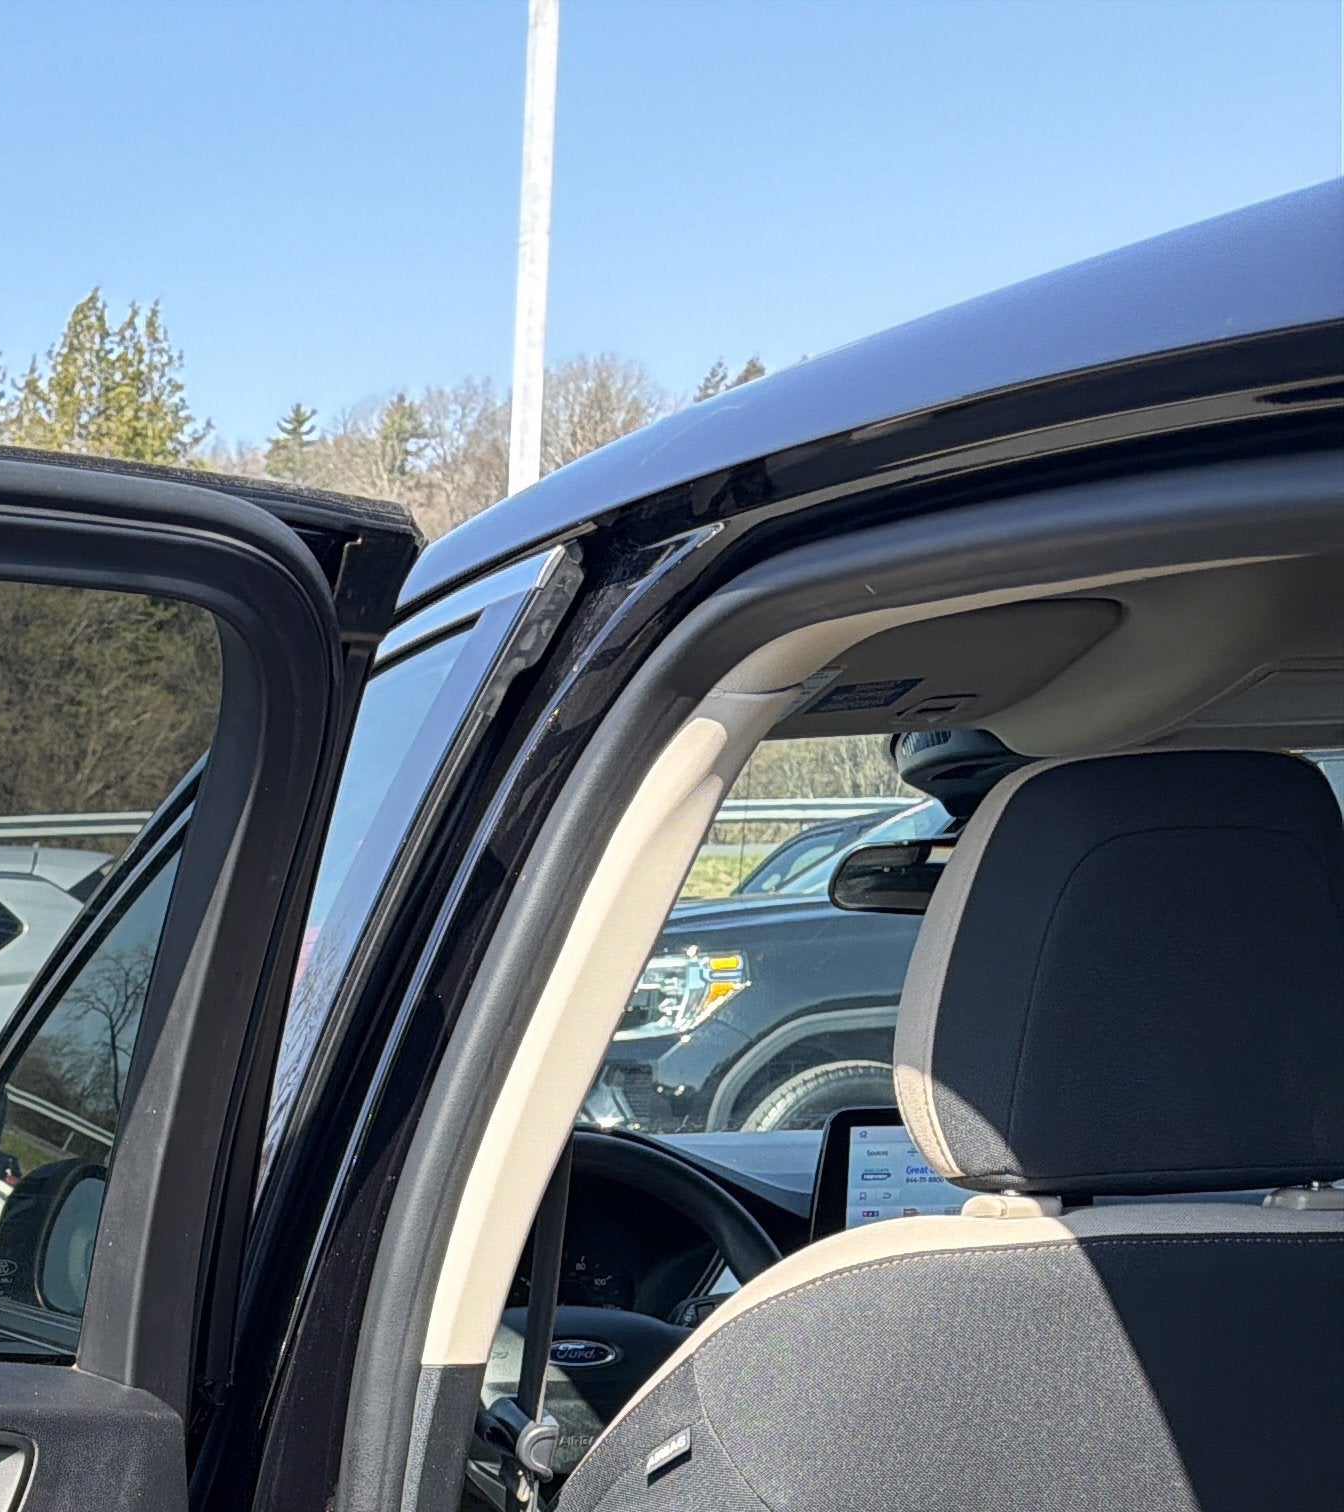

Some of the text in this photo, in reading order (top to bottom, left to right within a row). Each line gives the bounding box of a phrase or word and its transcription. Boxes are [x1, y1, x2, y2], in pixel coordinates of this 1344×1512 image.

[905, 1165, 929, 1176] Great
[593, 1278, 607, 1287] 100
[555, 1343, 597, 1360] Ford
[645, 1434, 687, 1470] AIRBAG
